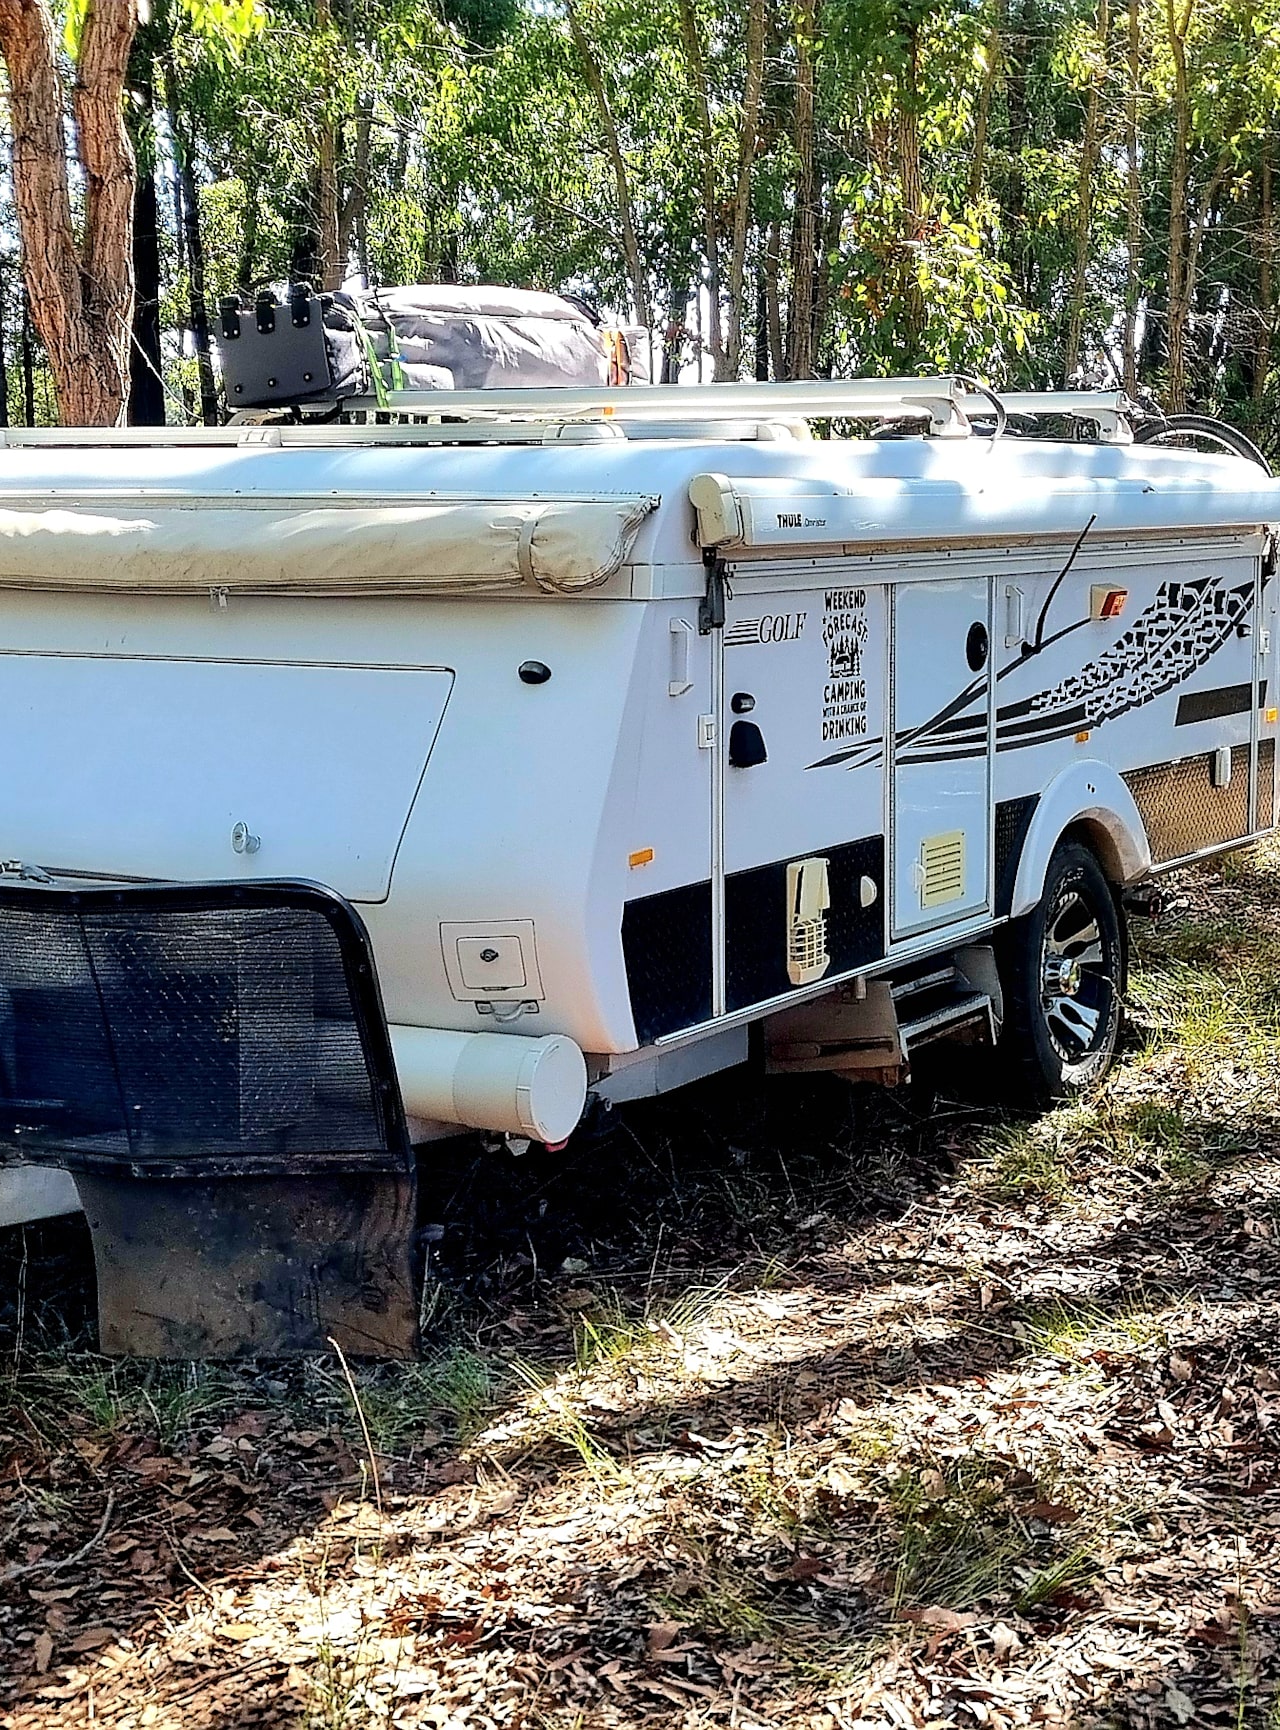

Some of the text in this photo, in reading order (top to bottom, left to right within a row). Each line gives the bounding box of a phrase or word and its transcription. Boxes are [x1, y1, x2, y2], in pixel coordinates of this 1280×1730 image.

[777, 513, 802, 528] THULE
[824, 589, 866, 611] WEEKEND
[760, 612, 807, 643] GOLF
[822, 613, 868, 648] FORECAST
[824, 680, 866, 703] CAMPING
[823, 715, 867, 740] DRINKING
